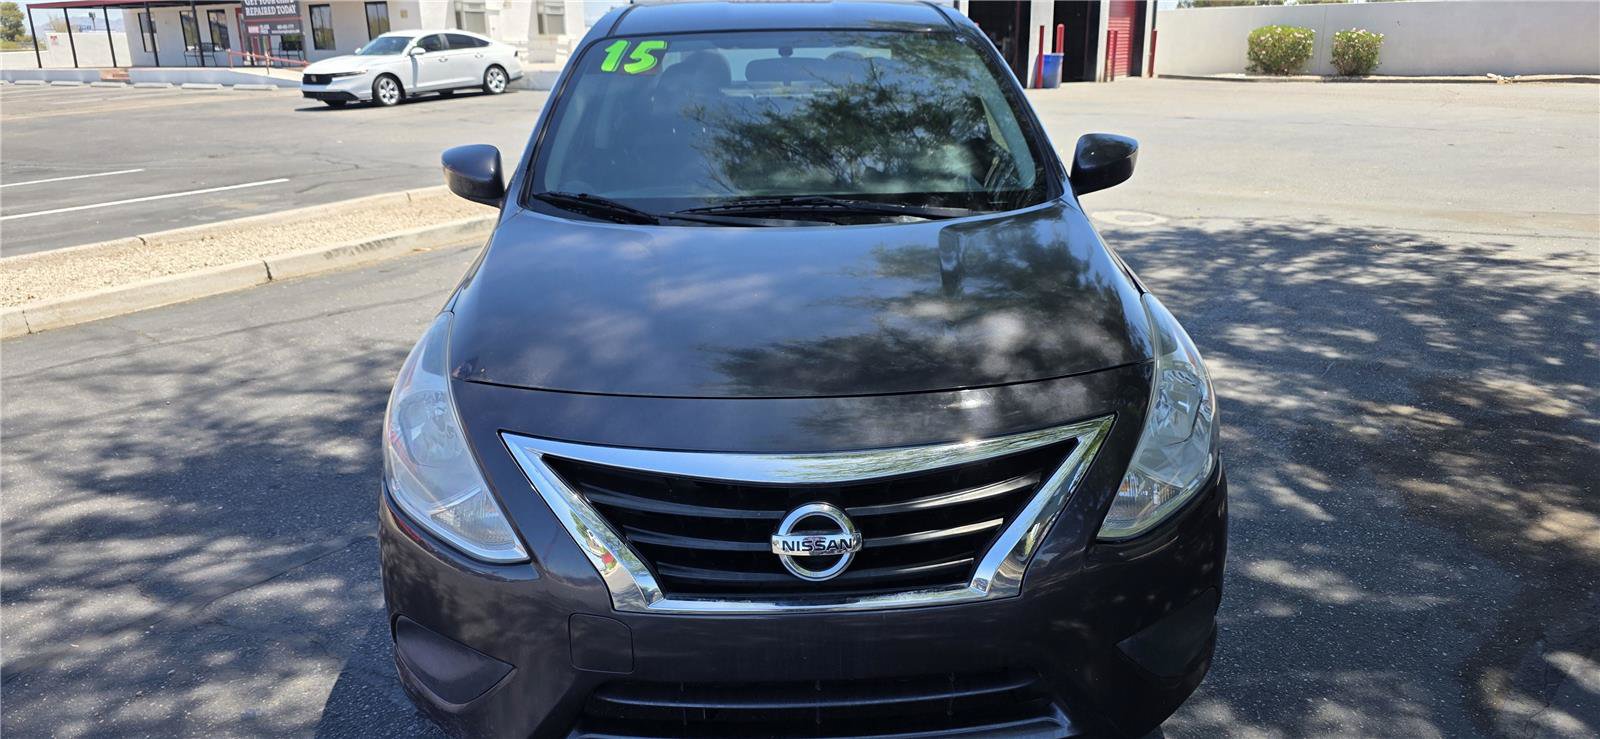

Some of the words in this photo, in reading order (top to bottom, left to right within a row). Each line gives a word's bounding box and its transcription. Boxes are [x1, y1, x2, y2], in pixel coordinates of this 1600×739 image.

[245, 6, 276, 16] REPAIRED
[276, 4, 297, 15] TODAY
[600, 39, 668, 75] 15
[782, 538, 852, 552] NISSAN
